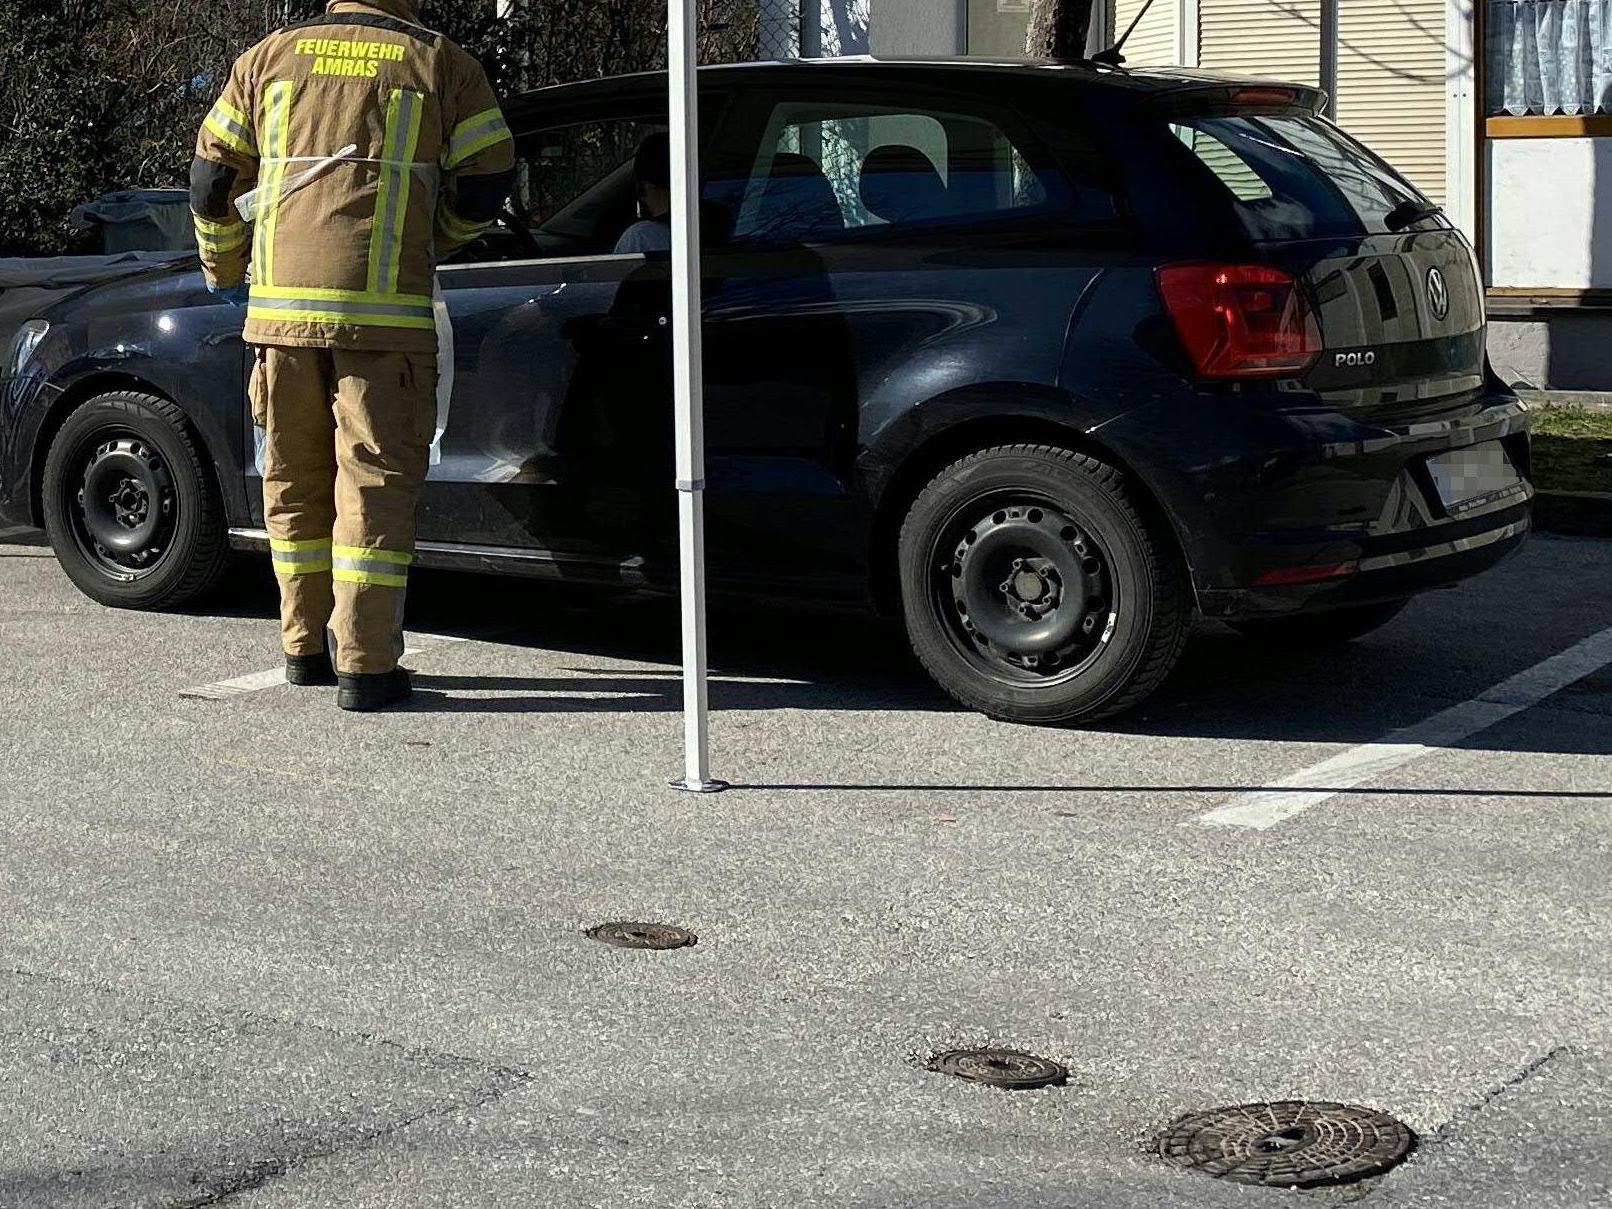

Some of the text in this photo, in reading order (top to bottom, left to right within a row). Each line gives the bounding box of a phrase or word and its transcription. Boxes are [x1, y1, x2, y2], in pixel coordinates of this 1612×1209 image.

[294, 38, 406, 62] FEUERWEHR
[311, 56, 378, 78] AMRAS
[1334, 350, 1376, 367] POLO
